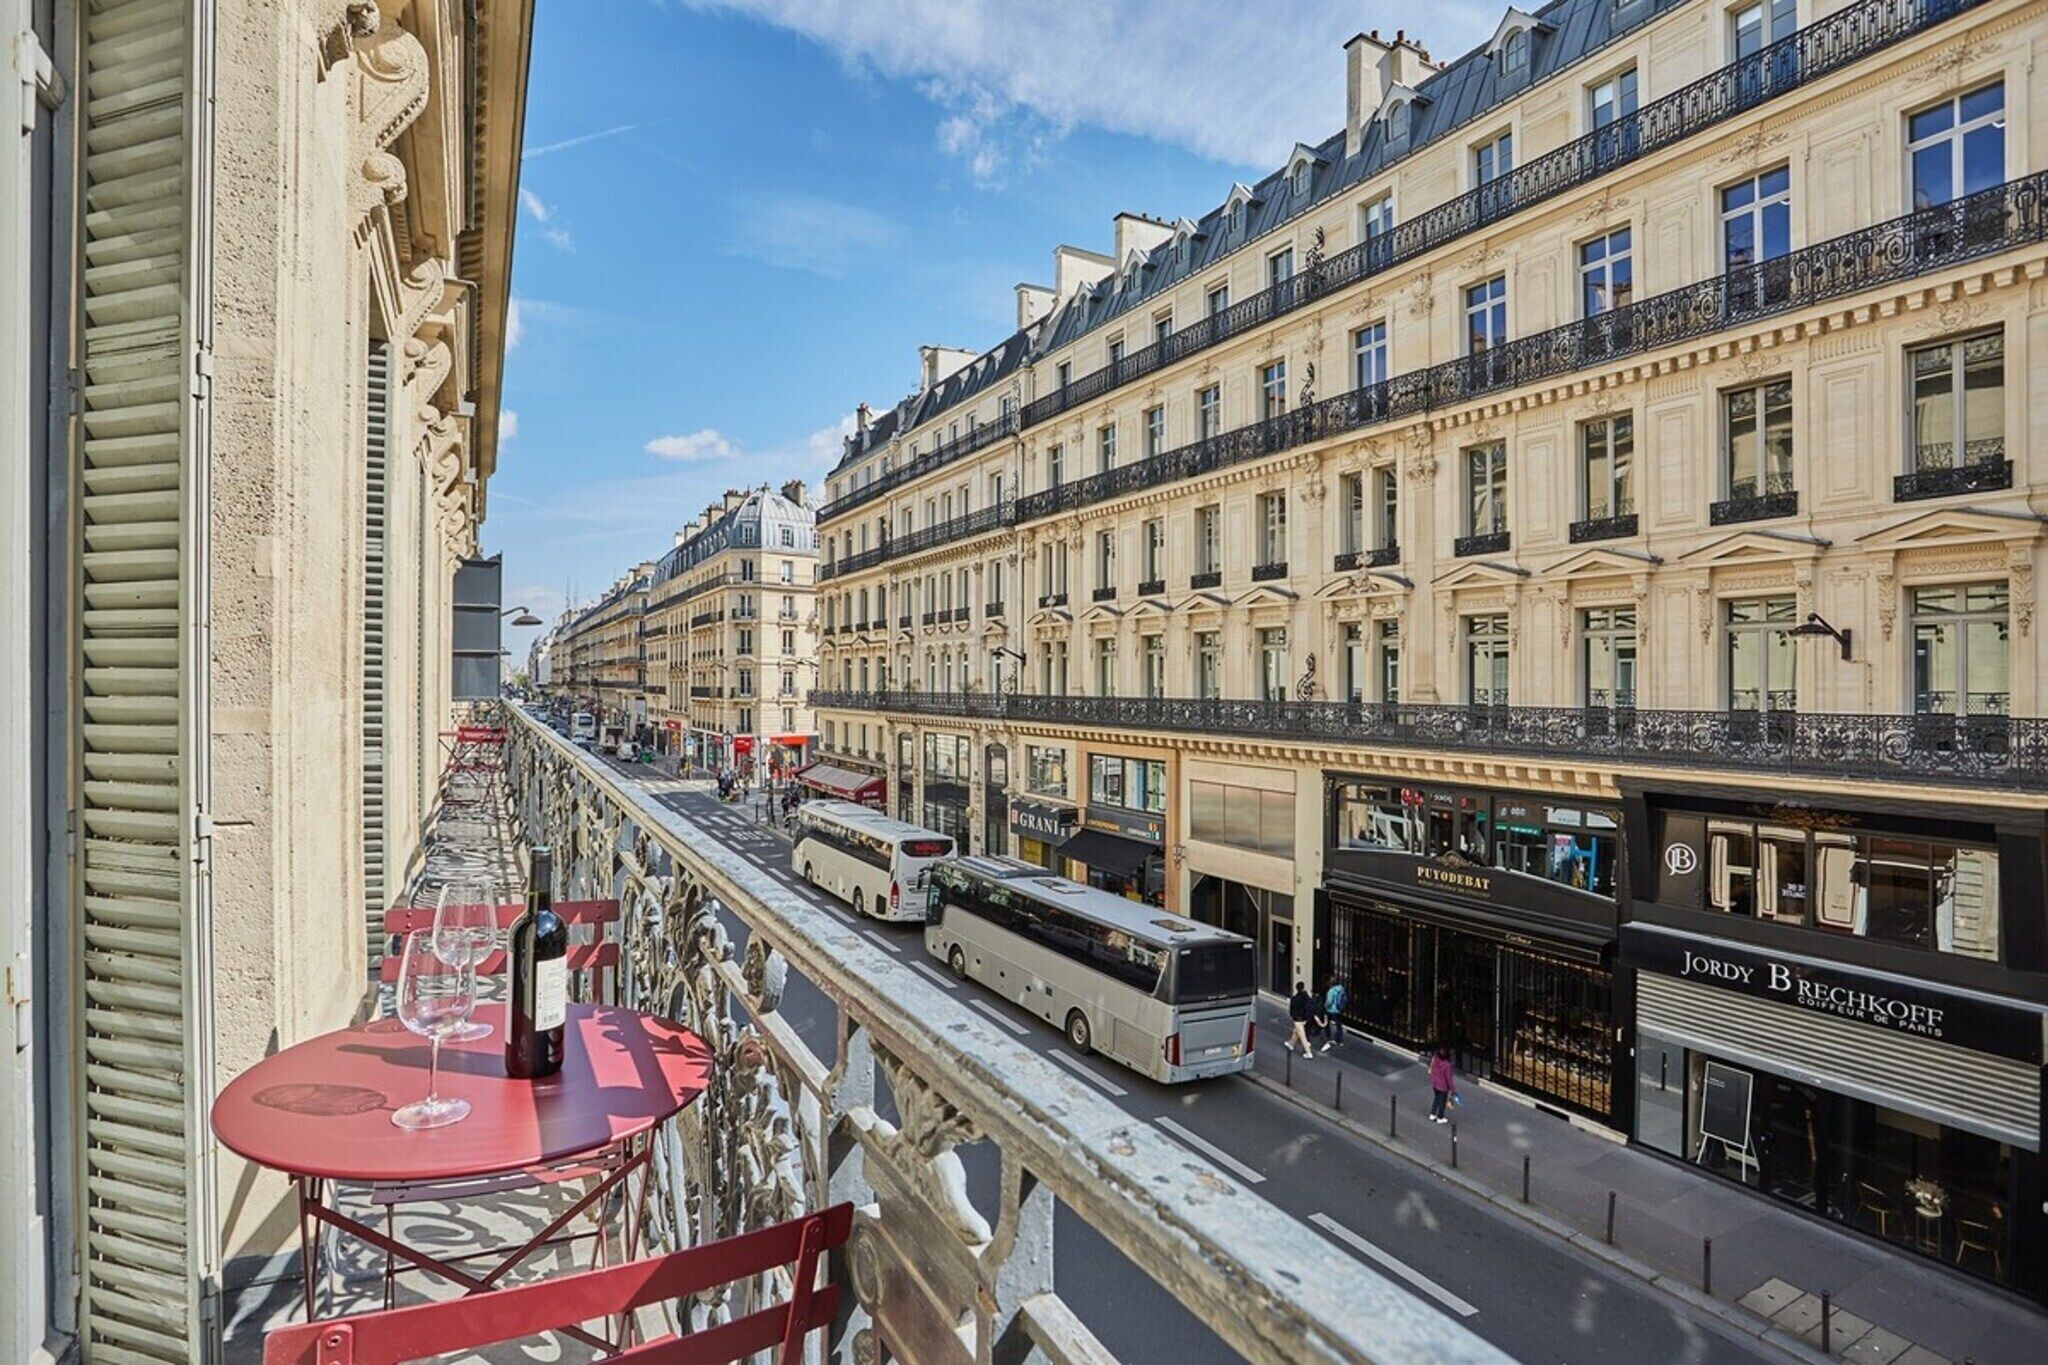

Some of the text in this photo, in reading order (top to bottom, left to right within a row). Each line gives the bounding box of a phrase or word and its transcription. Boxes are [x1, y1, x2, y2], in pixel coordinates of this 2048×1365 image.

[1416, 865, 1491, 890] PUYODEBAT
[1681, 950, 1944, 1028] JORDY BRECHKOFF
[1798, 996, 1943, 1038] COIFFEUR DE PARIS
